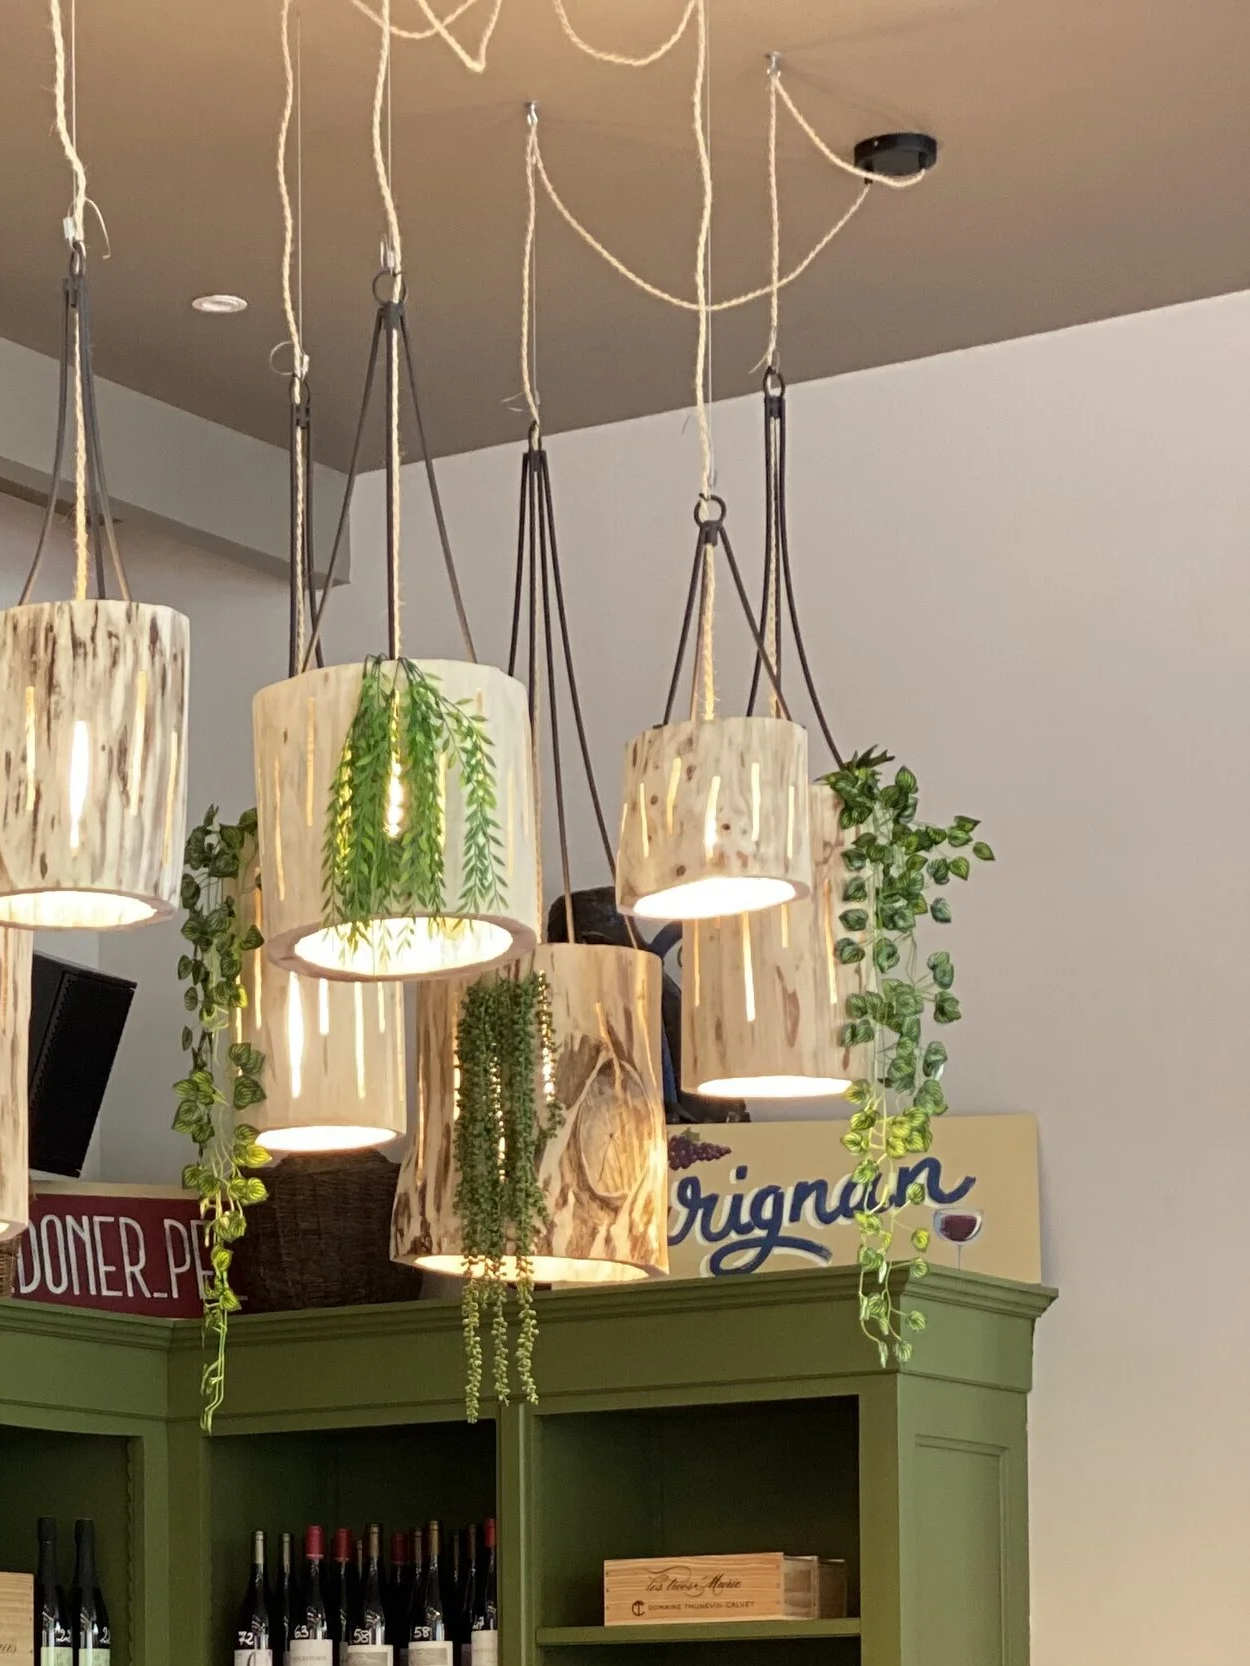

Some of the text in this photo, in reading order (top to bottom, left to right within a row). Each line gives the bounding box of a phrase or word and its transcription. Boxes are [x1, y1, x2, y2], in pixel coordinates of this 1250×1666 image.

[238, 1631, 255, 1646] 72
[294, 1625, 309, 1639] 63
[413, 1626, 431, 1639] 58
